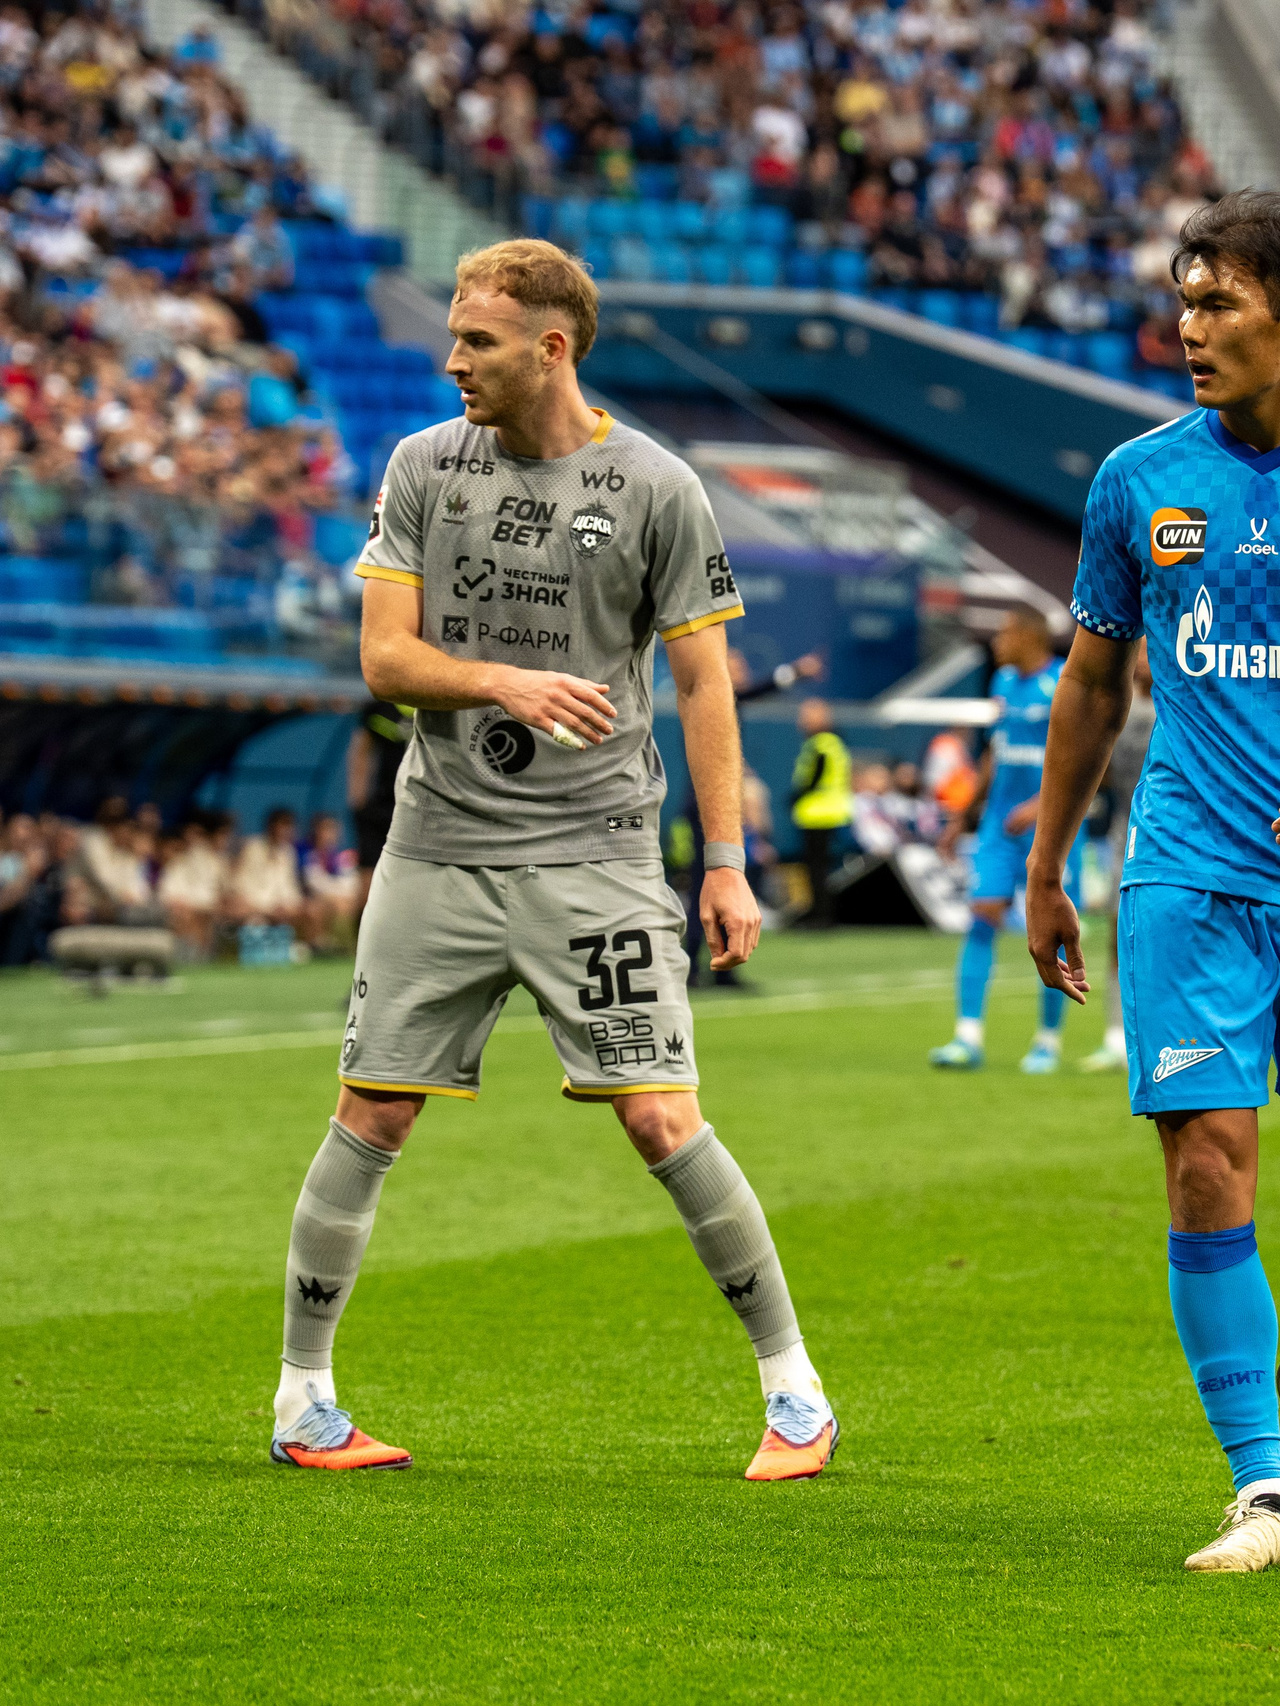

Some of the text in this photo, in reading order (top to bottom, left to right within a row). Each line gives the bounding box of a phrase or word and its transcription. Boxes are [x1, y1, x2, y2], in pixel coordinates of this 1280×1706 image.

[580, 466, 626, 492] wb
[496, 496, 558, 523] FON
[491, 520, 553, 548] BET
[572, 515, 612, 537] ЦСКА
[1162, 528, 1203, 545] WIN
[503, 567, 570, 586] ЧЕСТНЫЙ
[501, 582, 568, 608] ЗНАК
[478, 622, 570, 653] Р-ФАРМ
[568, 929, 659, 1012] 32
[1198, 1369, 1266, 1395] ЗЕНИТ
